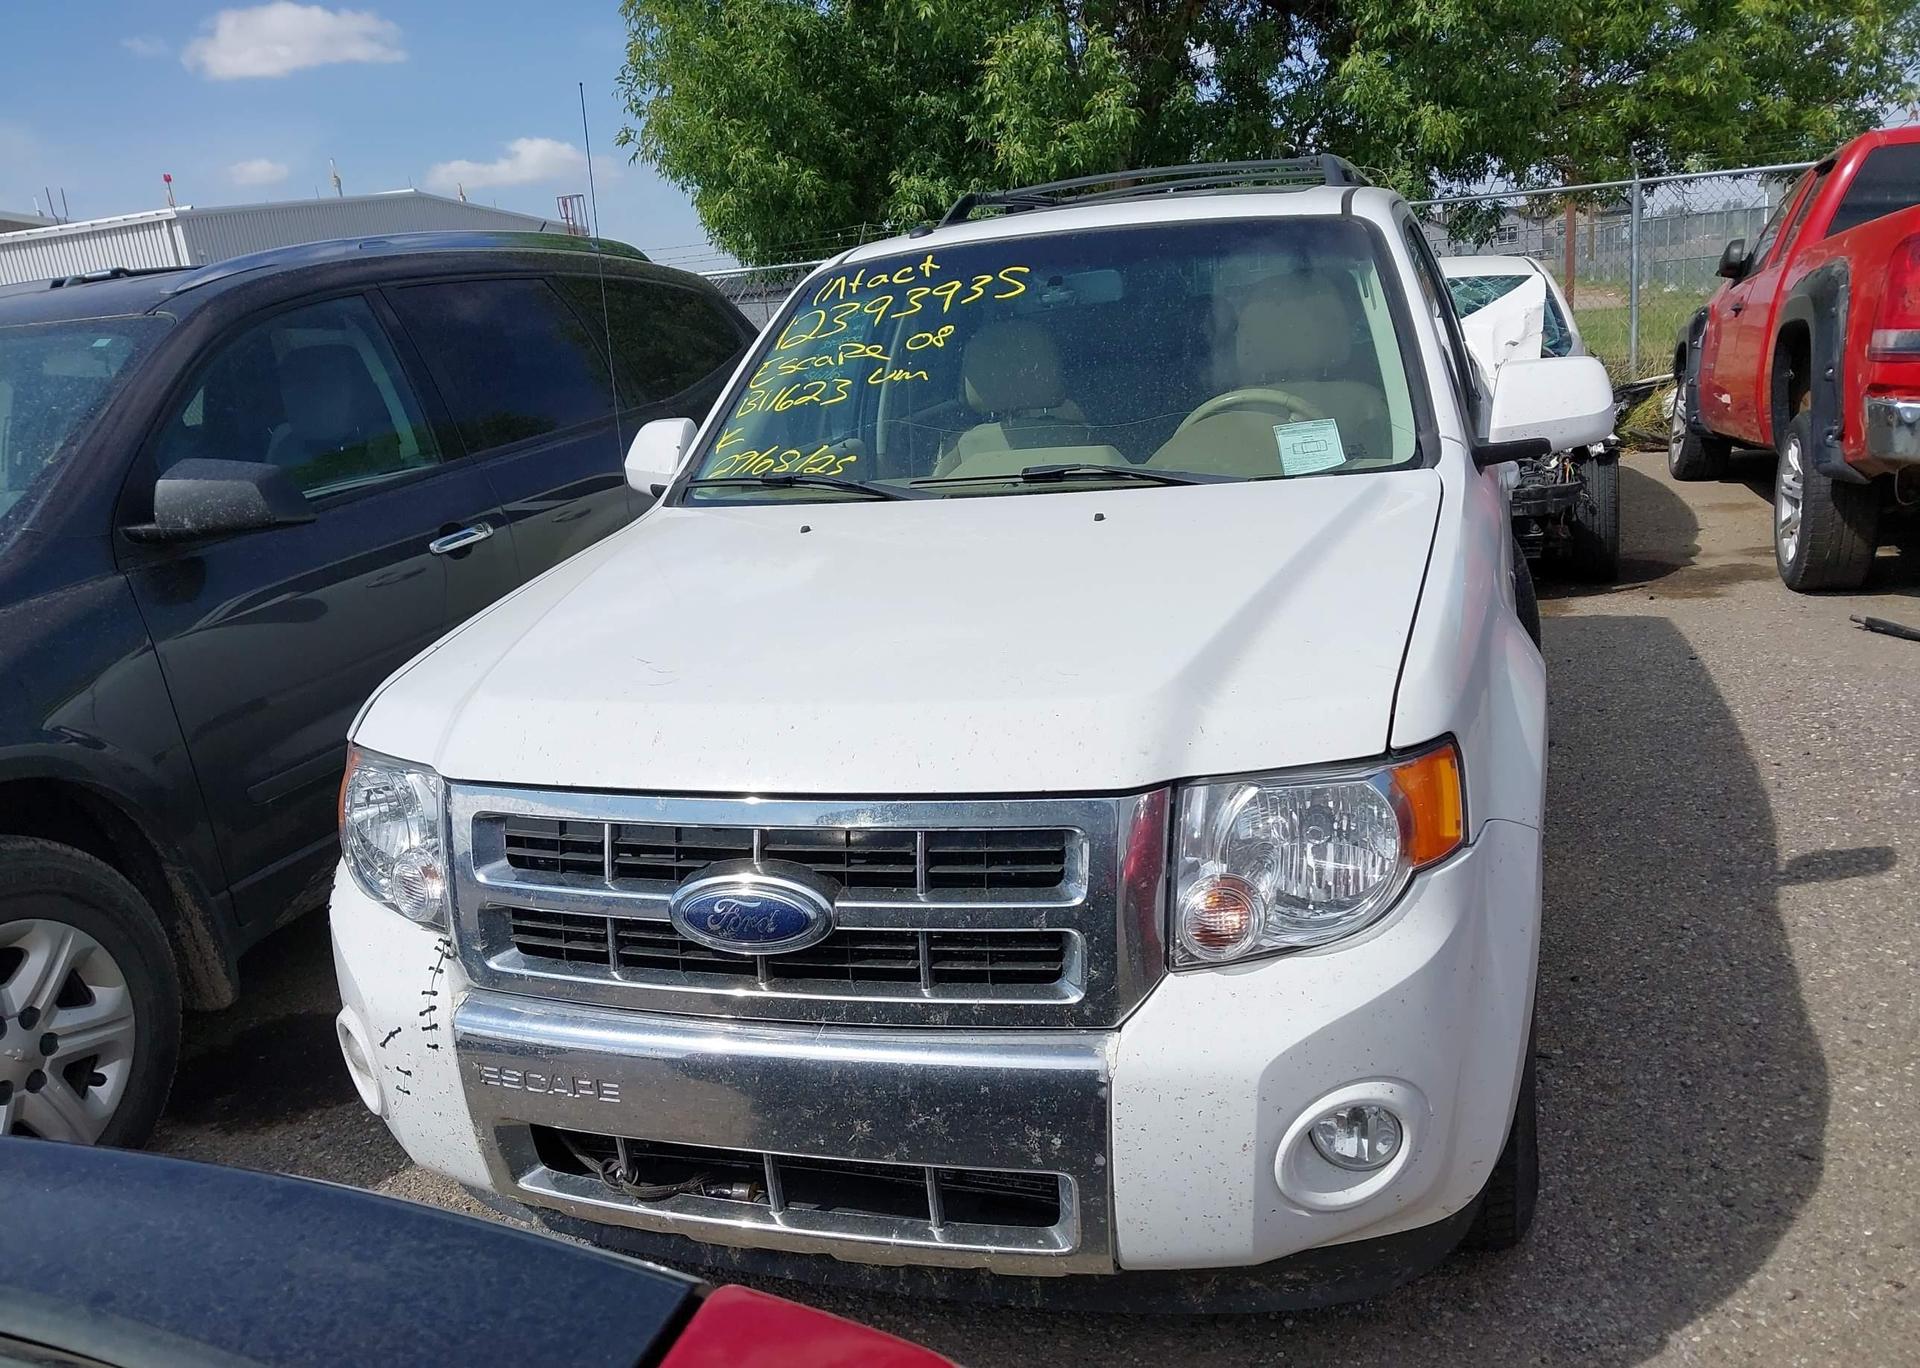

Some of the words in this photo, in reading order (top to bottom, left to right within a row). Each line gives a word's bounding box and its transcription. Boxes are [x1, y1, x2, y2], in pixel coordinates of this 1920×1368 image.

[906, 325, 955, 350] 08
[707, 898, 780, 934] Ford
[478, 1062, 621, 1103] ESCAPE
